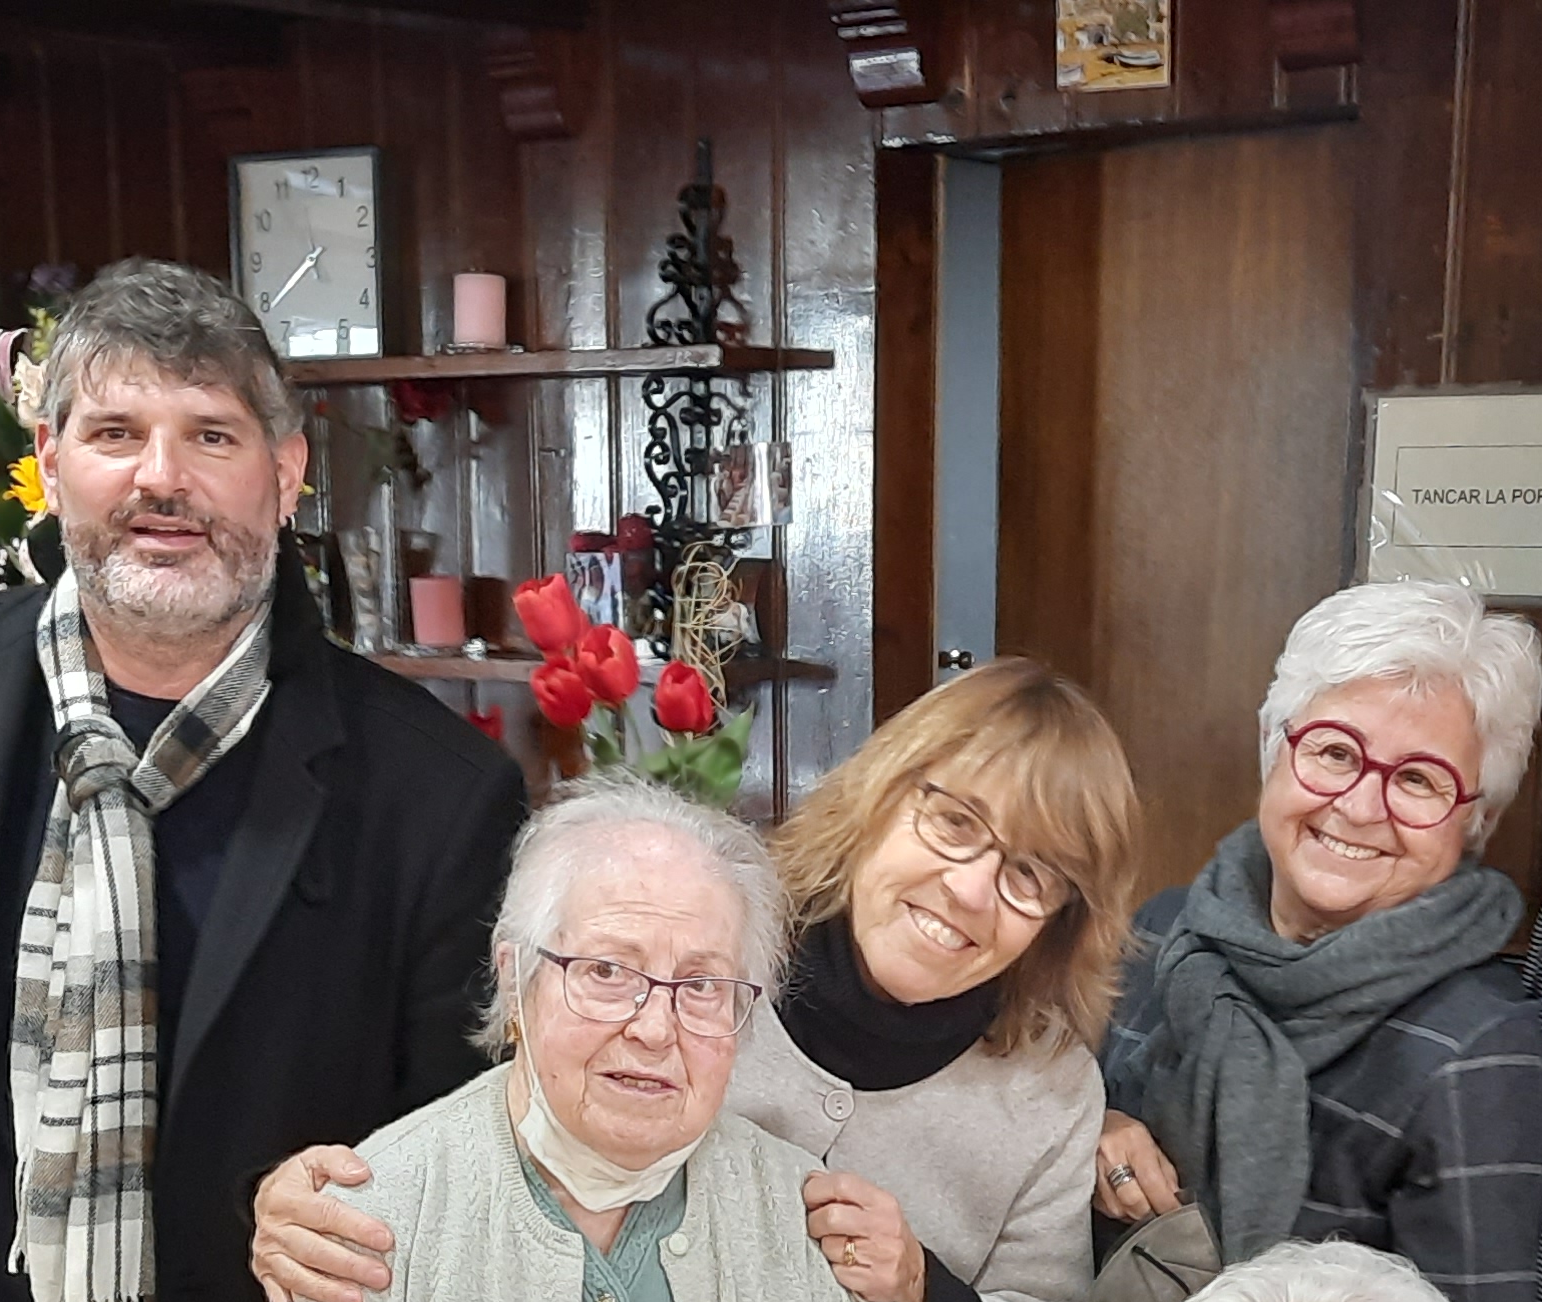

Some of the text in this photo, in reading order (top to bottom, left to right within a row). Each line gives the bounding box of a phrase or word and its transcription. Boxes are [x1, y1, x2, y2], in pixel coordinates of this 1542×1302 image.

[303, 167, 318, 189] 12
[338, 178, 346, 197] 1
[276, 181, 289, 199] 11
[256, 211, 271, 231] 10
[357, 206, 368, 227] 2
[252, 253, 262, 272] 9
[366, 247, 375, 268] 3
[261, 293, 270, 312] 8
[360, 289, 369, 308] 4
[281, 322, 291, 344] 7
[1412, 489, 1480, 505] TANCAR
[1486, 489, 1505, 505] LA
